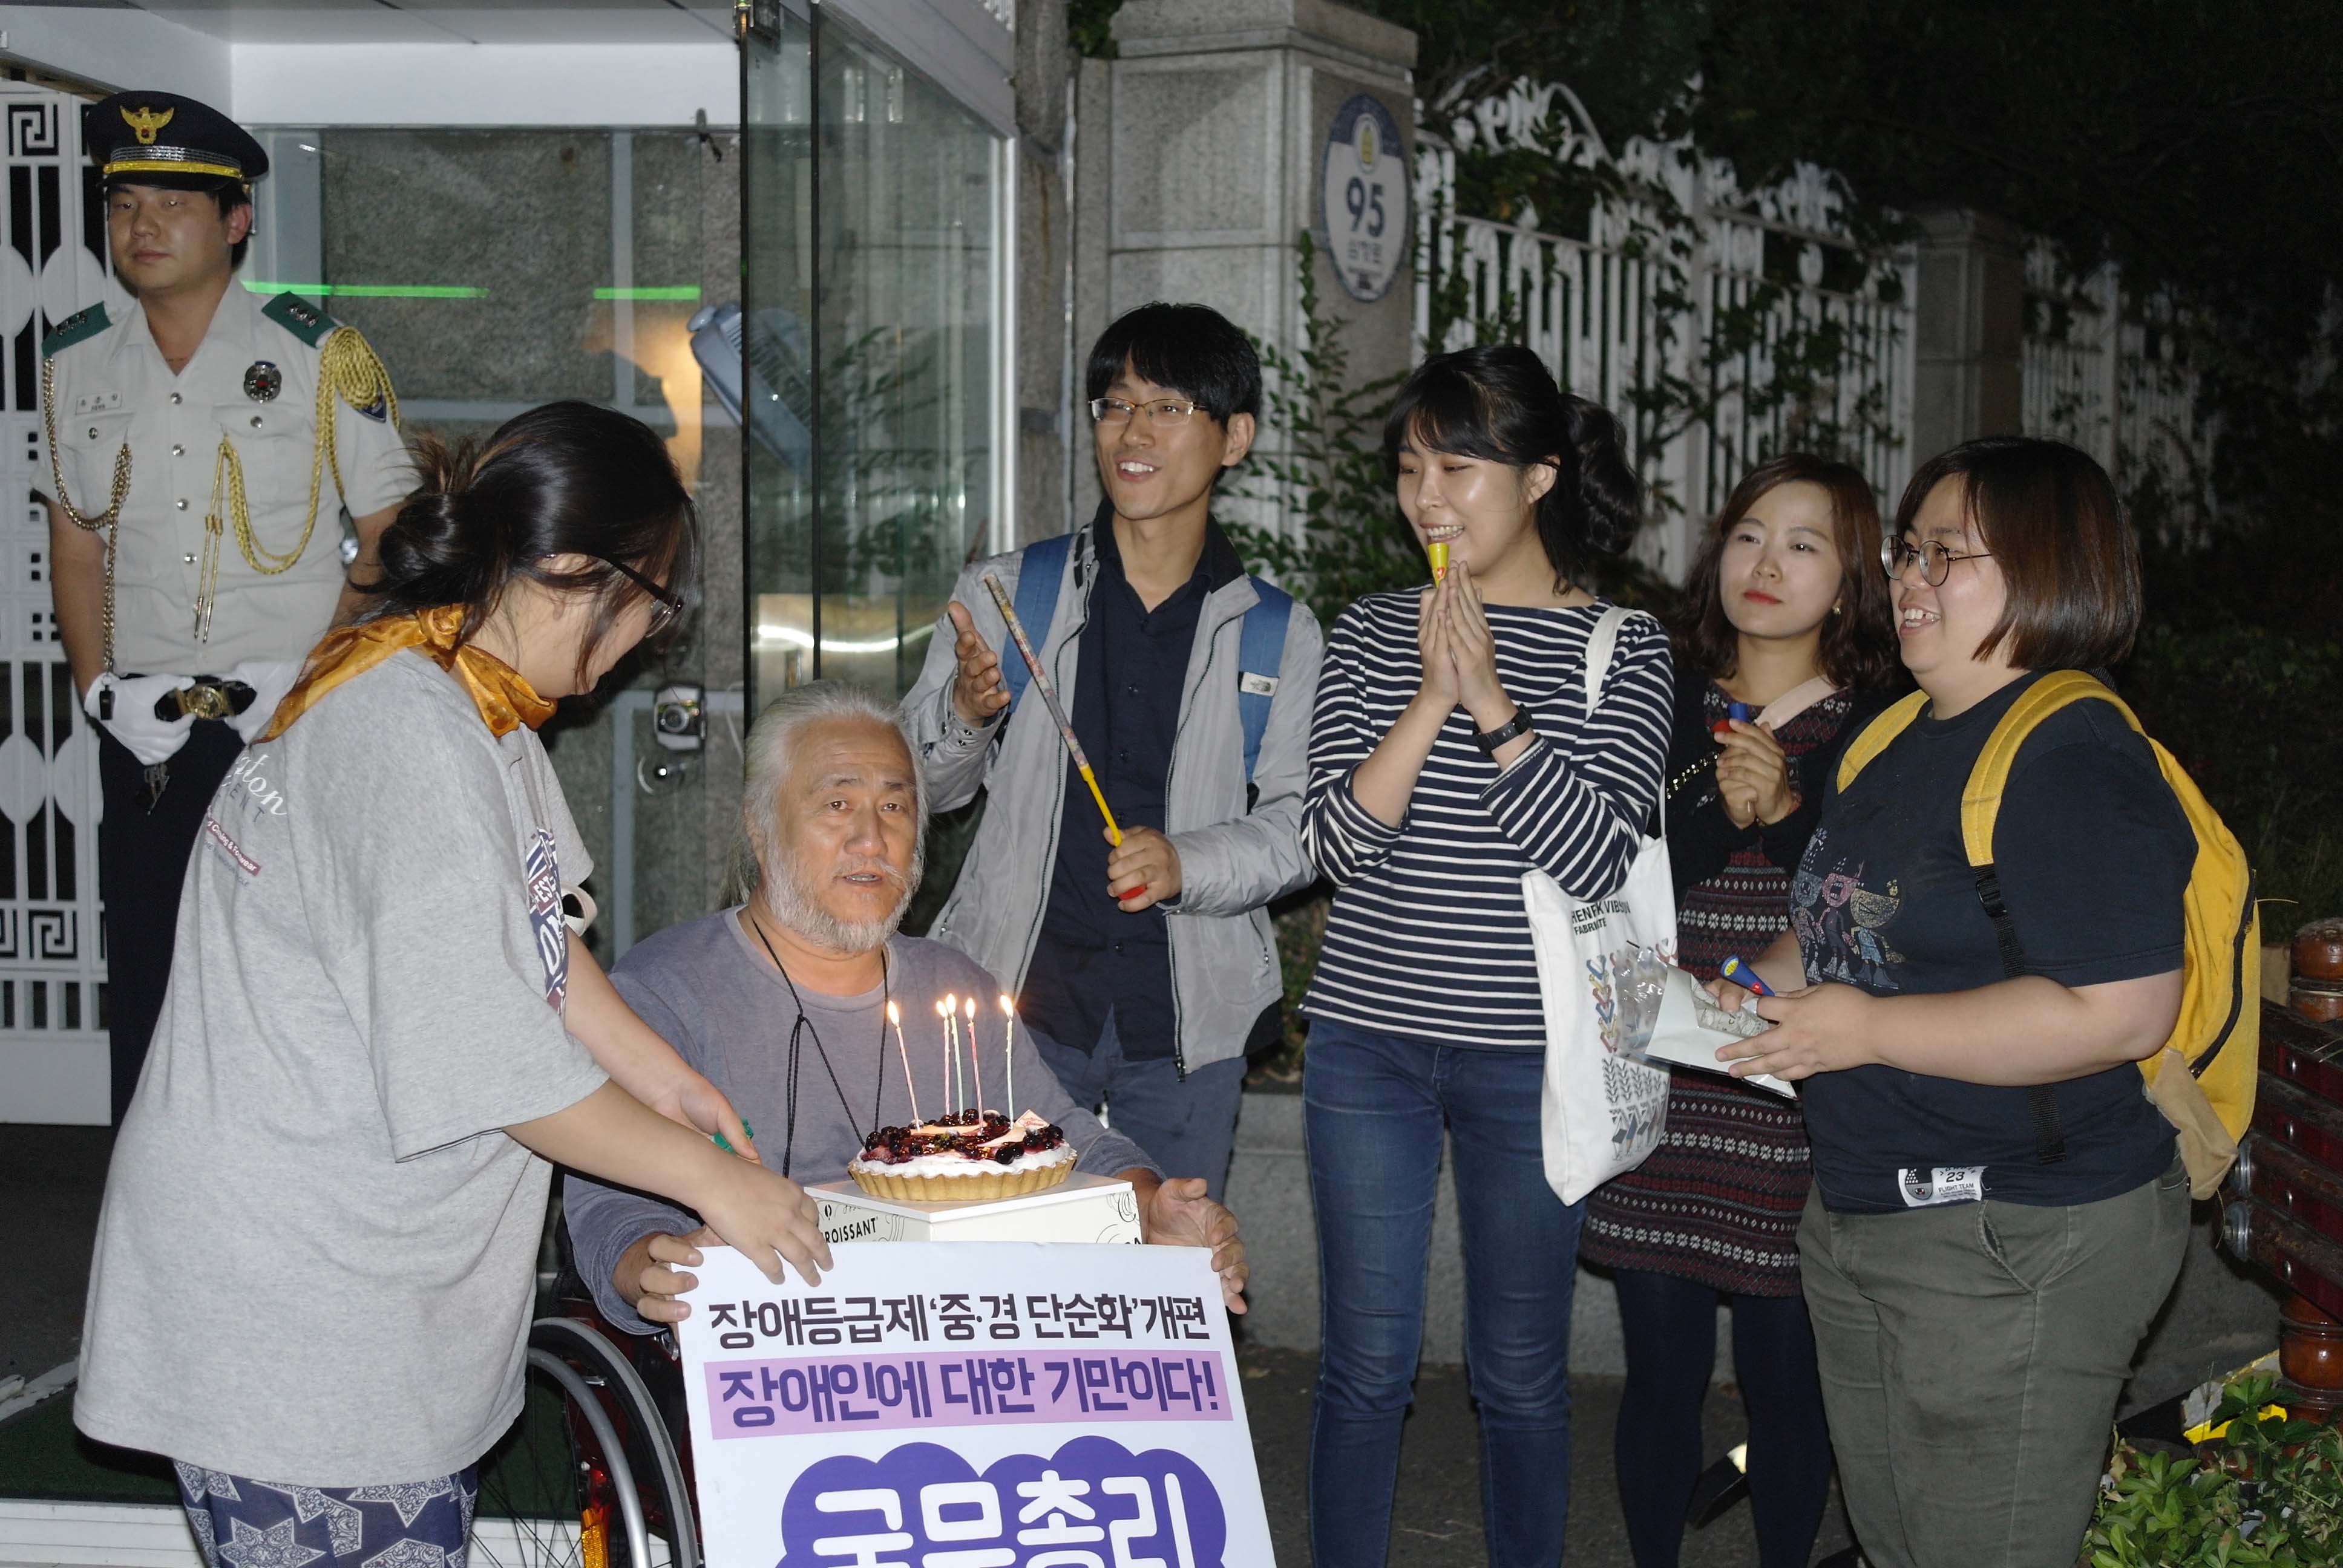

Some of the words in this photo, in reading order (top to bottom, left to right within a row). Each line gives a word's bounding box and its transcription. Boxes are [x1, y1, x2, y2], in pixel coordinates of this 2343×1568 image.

[1346, 177, 1385, 237] 95
[1946, 1171, 1965, 1183] 23
[821, 1217, 876, 1244] ROISSANT
[719, 1360, 932, 1428] 장애인에
[940, 1357, 1036, 1416] 대한
[1044, 1356, 1219, 1413] 기만이다!
